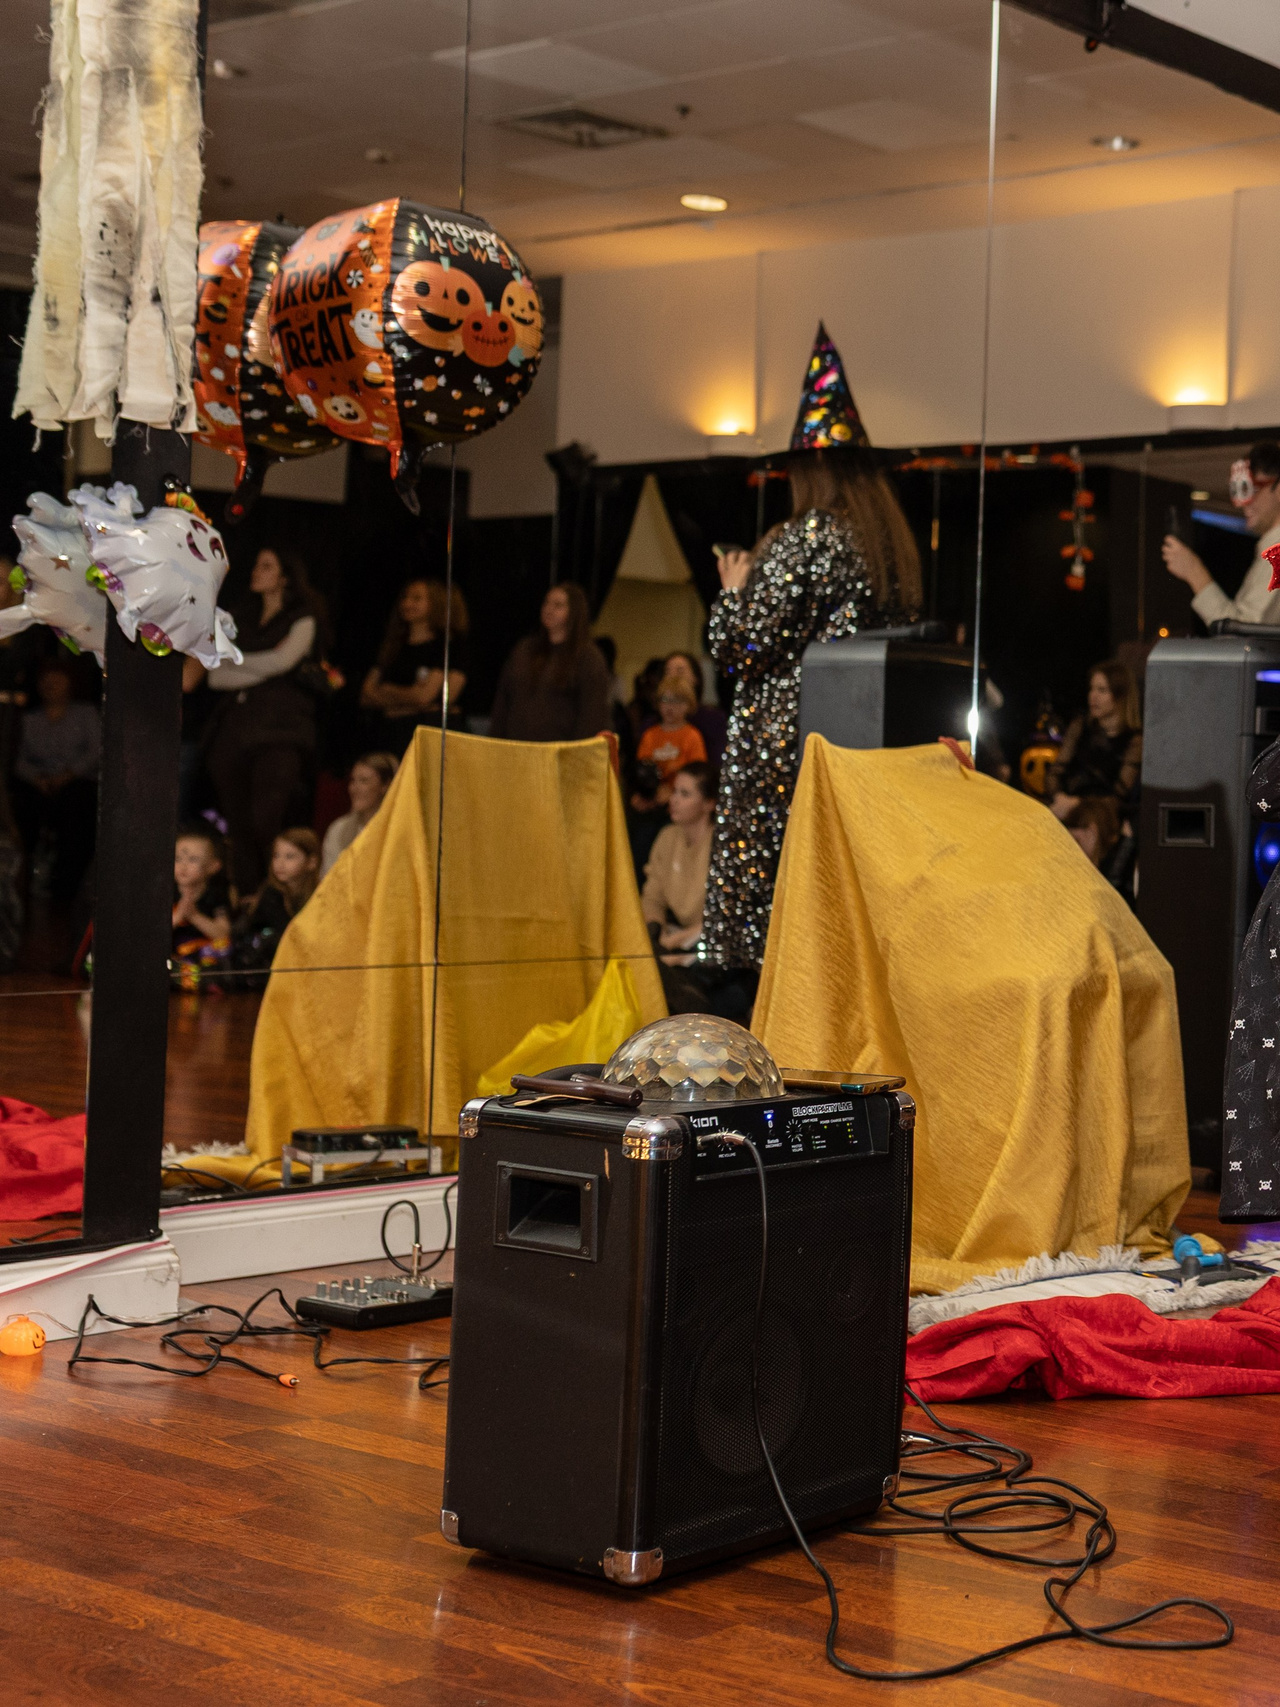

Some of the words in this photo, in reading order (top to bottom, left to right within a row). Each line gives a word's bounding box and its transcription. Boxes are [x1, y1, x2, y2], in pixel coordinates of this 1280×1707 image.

[408, 229, 521, 270] HALLOWEEN
[272, 303, 355, 374] TREAT
[792, 1105, 817, 1117] BLOCK
[817, 1103, 838, 1114] PARTY
